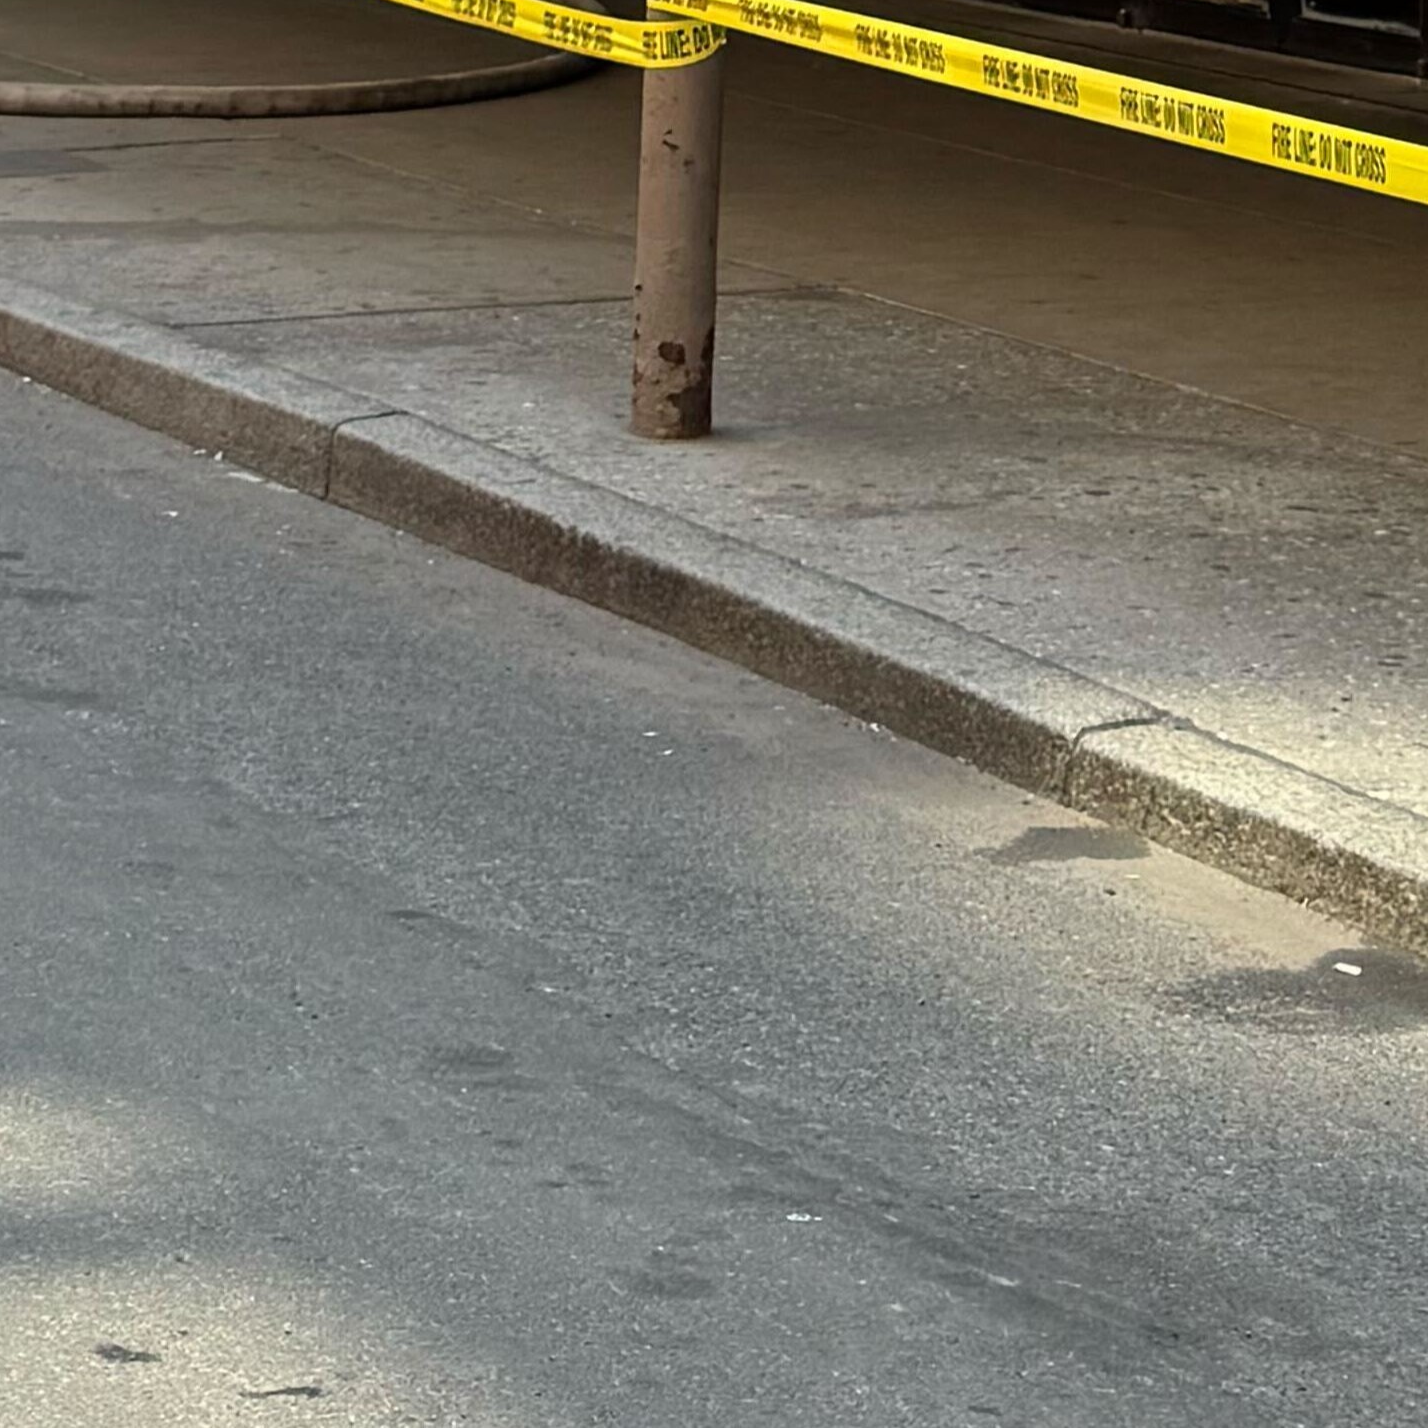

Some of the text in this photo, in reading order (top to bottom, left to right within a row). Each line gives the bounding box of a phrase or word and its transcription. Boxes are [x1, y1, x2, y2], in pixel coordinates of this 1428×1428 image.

[1272, 122, 1291, 160] FIRE
[1319, 133, 1332, 171] DO
[1335, 136, 1352, 176] NOT
[1355, 142, 1386, 184] CROSS
